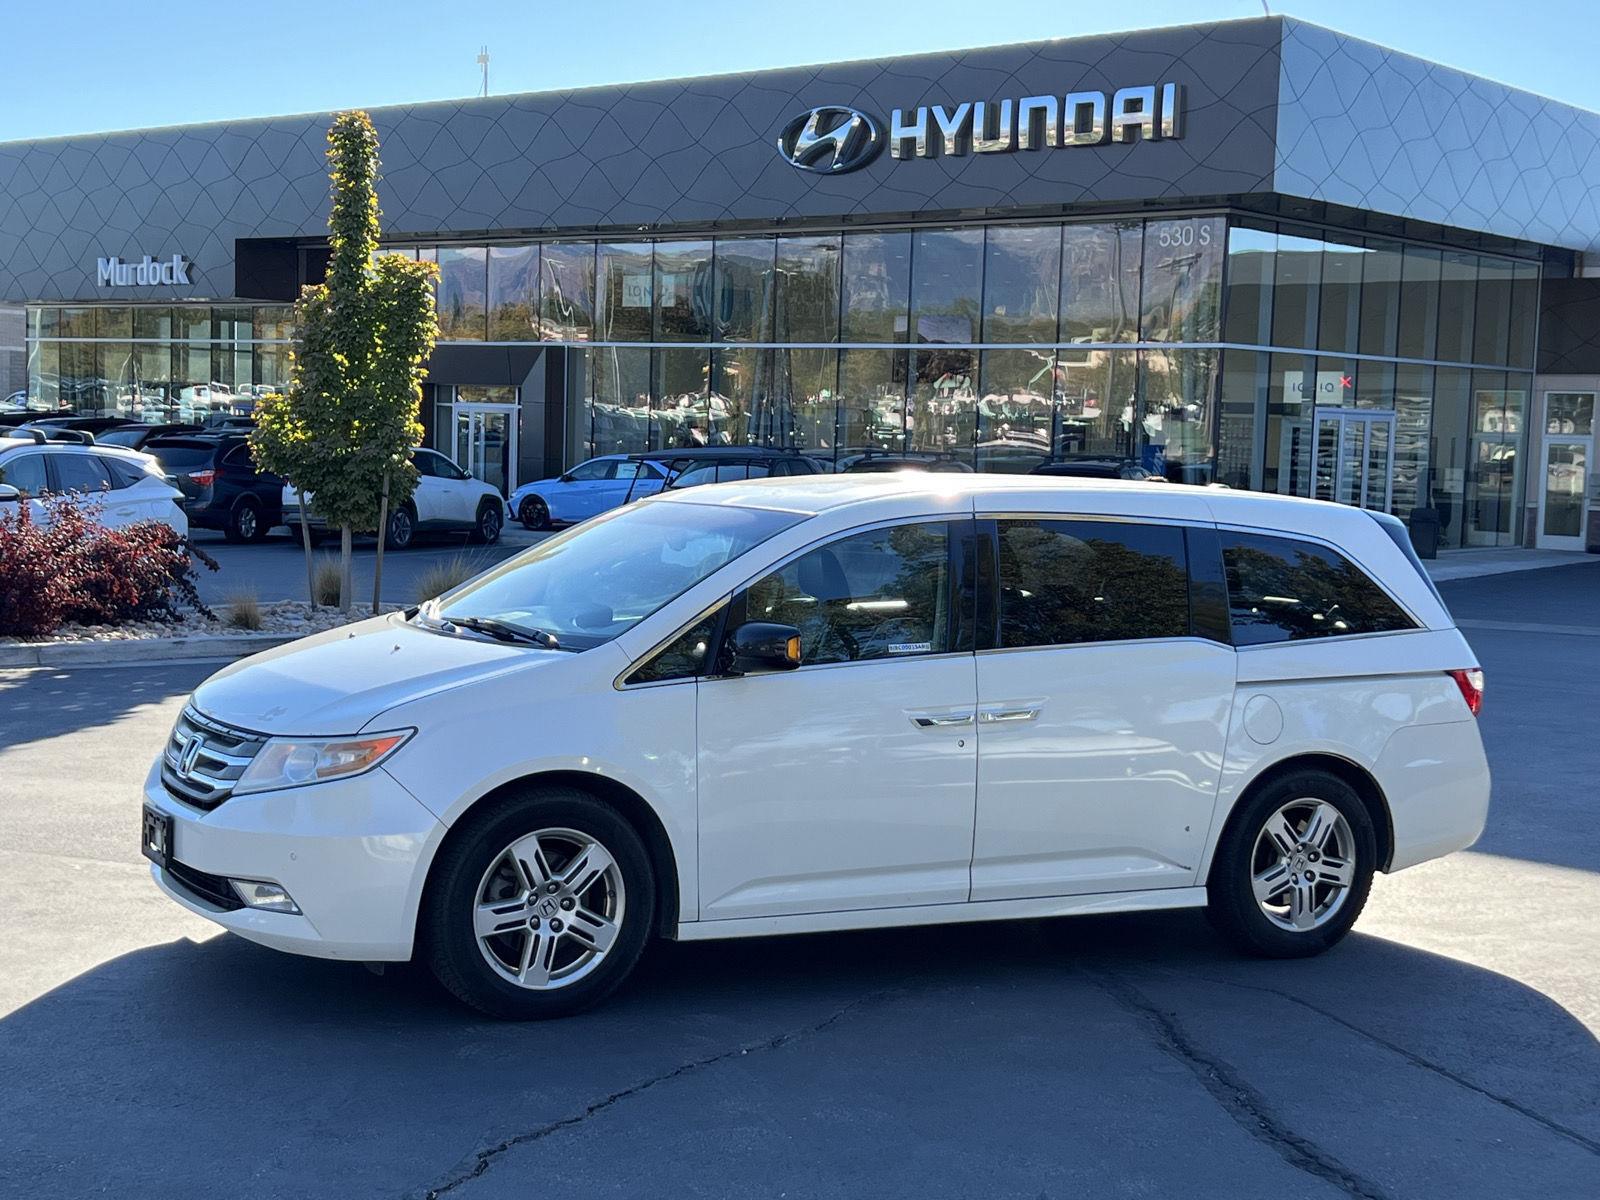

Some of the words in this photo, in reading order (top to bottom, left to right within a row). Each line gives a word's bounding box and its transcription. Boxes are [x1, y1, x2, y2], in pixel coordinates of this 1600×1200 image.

[891, 83, 1179, 158] HYUNDAI
[1160, 226, 1194, 247] 530
[1199, 225, 1210, 245] S
[97, 254, 190, 287] Murdock
